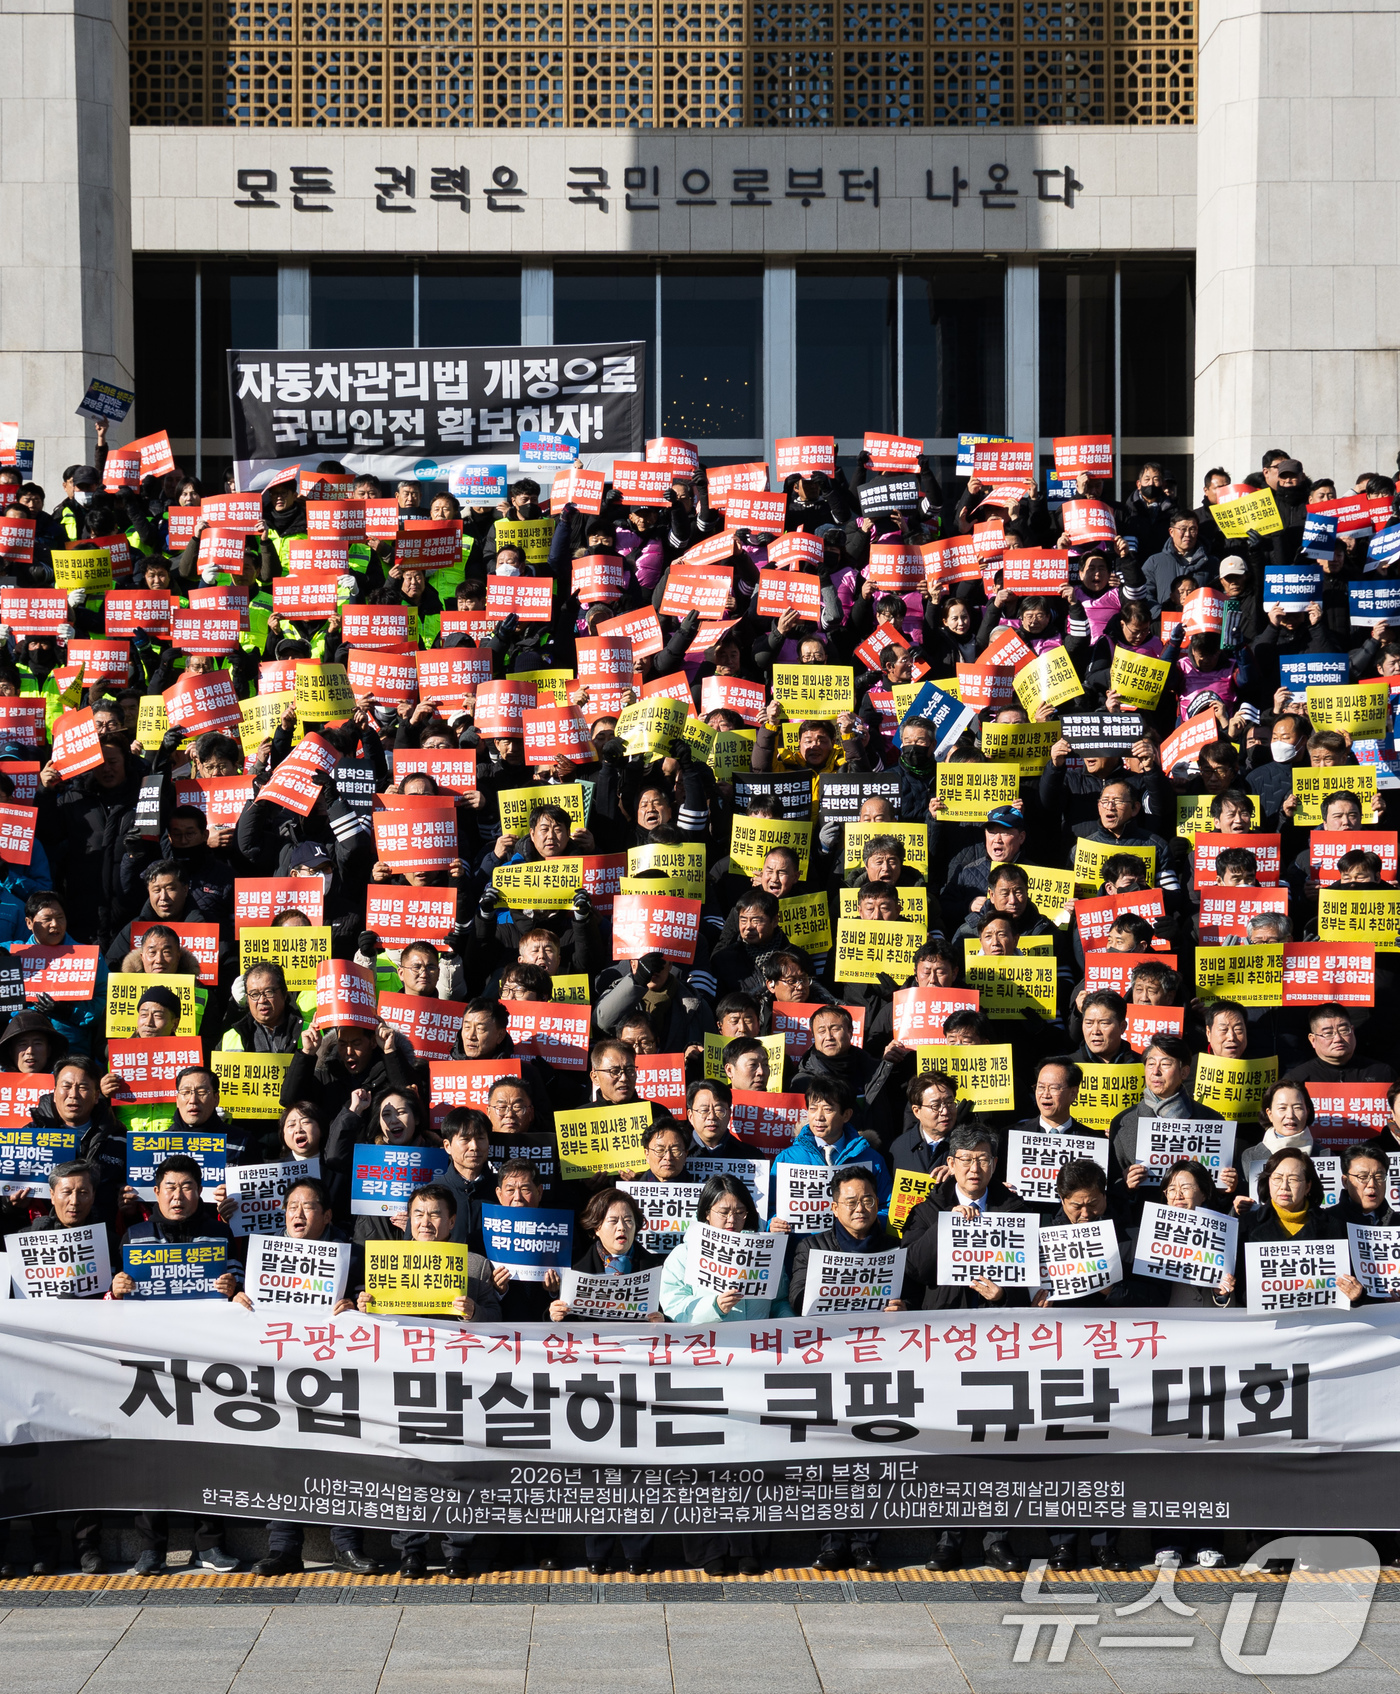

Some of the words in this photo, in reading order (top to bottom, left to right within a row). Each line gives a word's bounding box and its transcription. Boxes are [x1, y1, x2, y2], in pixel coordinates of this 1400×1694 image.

[234, 166, 333, 213] 모든
[375, 165, 527, 213] 권력은
[566, 165, 879, 214] 국민으로부터
[926, 163, 1084, 208] 나온다
[237, 360, 468, 402] 자동차관리법
[484, 356, 637, 399] 개정으로
[272, 408, 425, 447] 국민안전
[437, 405, 603, 445] 확보하자!
[538, 435, 561, 443] 쿠팡은
[615, 470, 638, 479] 정비업
[640, 471, 672, 480] 생계위협
[614, 480, 637, 489] 쿠팡은
[639, 480, 672, 491] 각성하라!
[1005, 560, 1031, 570] 정비업
[1033, 559, 1067, 570] 생계위협
[1004, 570, 1029, 580] 쿠팡은
[1032, 570, 1068, 580] 각성하라!
[107, 600, 132, 611] 정비업
[135, 599, 169, 610] 생계위협
[106, 610, 131, 621] 쿠팡은
[133, 610, 170, 621] 각성하라!
[1282, 663, 1306, 672] 쿠팡은
[1290, 674, 1306, 683] 즉각
[1308, 673, 1341, 683] 인하하라!
[940, 774, 963, 786] 정비업
[967, 774, 998, 786] 제외사항
[1001, 774, 1016, 786] 개정
[823, 784, 860, 796] 불량정비
[863, 784, 899, 795] 정착으로
[939, 789, 963, 801] 정부는
[965, 789, 980, 800] 즉시
[983, 788, 1017, 801] 추진하라!
[822, 798, 858, 809] 국민안전
[378, 824, 409, 837] 정비업
[412, 821, 455, 835] 생계위협
[377, 838, 407, 851] 쿠팡은
[411, 835, 457, 848] 각성하라!
[370, 899, 404, 912] 정비업
[408, 900, 453, 914] 생계위협
[367, 913, 401, 926] 쿠팡은
[405, 914, 455, 929] 각성하라!
[1200, 958, 1226, 971] 정비업
[1229, 957, 1264, 970] 제외사항
[1266, 955, 1283, 967] 개정
[1286, 956, 1321, 969] 정비업
[1325, 956, 1372, 970] 생계위협
[1198, 973, 1224, 987] 정부는
[1227, 972, 1244, 985] 즉시
[1283, 971, 1318, 984] 쿠팡은
[1321, 971, 1374, 985] 각성하라!
[560, 1124, 587, 1139] 정비업
[591, 1119, 627, 1135] 제외사항
[630, 1115, 648, 1129] 개정
[1152, 1121, 1191, 1134] 대한민국
[1194, 1122, 1223, 1134] 자영업
[560, 1142, 588, 1156] 정부는
[591, 1137, 609, 1152] 즉시
[1151, 1134, 1221, 1153] 말살하는
[384, 1151, 421, 1166] 쿠팡은
[356, 1166, 407, 1182] 골목상권
[362, 1181, 387, 1196] 즉각
[483, 1217, 512, 1235] 쿠팡은
[514, 1220, 569, 1236] 배달수수료
[952, 1217, 992, 1227] 대한민국
[996, 1217, 1026, 1228] 자영업
[1156, 1209, 1197, 1225] 대한민국
[1200, 1216, 1227, 1233] 자영업
[18, 1235, 58, 1246] 대한민국
[62, 1229, 93, 1242] 자영업
[491, 1236, 511, 1249] 즉각
[514, 1238, 560, 1253] 인하하라!
[701, 1228, 741, 1247] 대한민국
[744, 1238, 774, 1248] 자영업
[952, 1229, 1025, 1248] 말살하는
[1154, 1221, 1226, 1252] 말살하는
[22, 1243, 95, 1266] 말살하는
[129, 1249, 182, 1265] 중소마트
[186, 1247, 226, 1262] 생존권
[700, 1240, 772, 1268] 말살하는
[952, 1250, 1025, 1263] COUPANG
[1151, 1242, 1224, 1266] COUPANG
[1260, 1245, 1301, 1257] 대한민국
[1305, 1244, 1335, 1255] 자영업
[370, 1255, 398, 1271] 정비업
[403, 1255, 442, 1271] 제외사항
[445, 1256, 464, 1272] 개정
[823, 1255, 865, 1265] 대한민국
[868, 1254, 895, 1266] 자영업
[1260, 1257, 1336, 1278] 말살하는
[25, 1262, 97, 1279] COUPANG
[151, 1264, 205, 1278] 파괴하는
[700, 1257, 769, 1280] COUPANG
[821, 1267, 893, 1284] 말살하는
[952, 1265, 1026, 1282] 규탄한다!
[1147, 1256, 1223, 1284] 규탄한다!
[28, 1276, 98, 1297] 규탄한다!
[368, 1274, 397, 1289] 정부는
[400, 1273, 420, 1288] 즉시
[423, 1272, 465, 1289] 추진하라!
[578, 1276, 619, 1286] 대한민국
[623, 1273, 650, 1285] 자영업
[698, 1275, 767, 1296] 규탄한다!
[1261, 1277, 1337, 1292] COUPANG
[575, 1286, 649, 1302] 말살하는
[819, 1285, 891, 1297] COUPANG
[573, 1299, 648, 1312] COUPANG
[816, 1298, 890, 1312] 규탄한다!
[1261, 1291, 1337, 1310] 규탄한다!
[259, 1321, 381, 1362] 쿠팡의
[402, 1328, 521, 1366] 멈추지
[541, 1332, 628, 1366] 않는
[638, 1330, 734, 1368] 갑질,
[750, 1325, 833, 1367] 벼랑
[845, 1326, 888, 1364] 끝
[899, 1321, 1064, 1364] 자영업의
[1083, 1321, 1168, 1362] 절규
[118, 1359, 363, 1439] 자영업
[392, 1370, 729, 1450] 말살하는
[760, 1370, 924, 1443] 쿠팡
[956, 1368, 1119, 1442] 규탄
[1151, 1363, 1311, 1441] 대회
[510, 1467, 582, 1485] 2026년
[591, 1467, 622, 1484] 1월
[631, 1468, 699, 1485] 7일(수)
[709, 1469, 764, 1484] 14:00
[785, 1465, 822, 1483] 국회
[831, 1462, 870, 1481] 본청
[878, 1461, 919, 1481] 계단
[304, 1476, 461, 1504] (사)한국외식업중앙회
[757, 1484, 881, 1502] (사)한국마트협회
[901, 1480, 1125, 1499] (사)한국지역경제살리기중앙회
[202, 1488, 427, 1522] 한국중소상인자영업자총연합회
[446, 1506, 655, 1525] (사)한국통신판매사업자협회
[673, 1503, 865, 1524] (사)한국휴게음식업중앙회
[883, 1501, 1009, 1519] (사)대한제과협회
[1028, 1500, 1126, 1518] 더불어민주당
[1131, 1501, 1230, 1519] 을지로위원회
